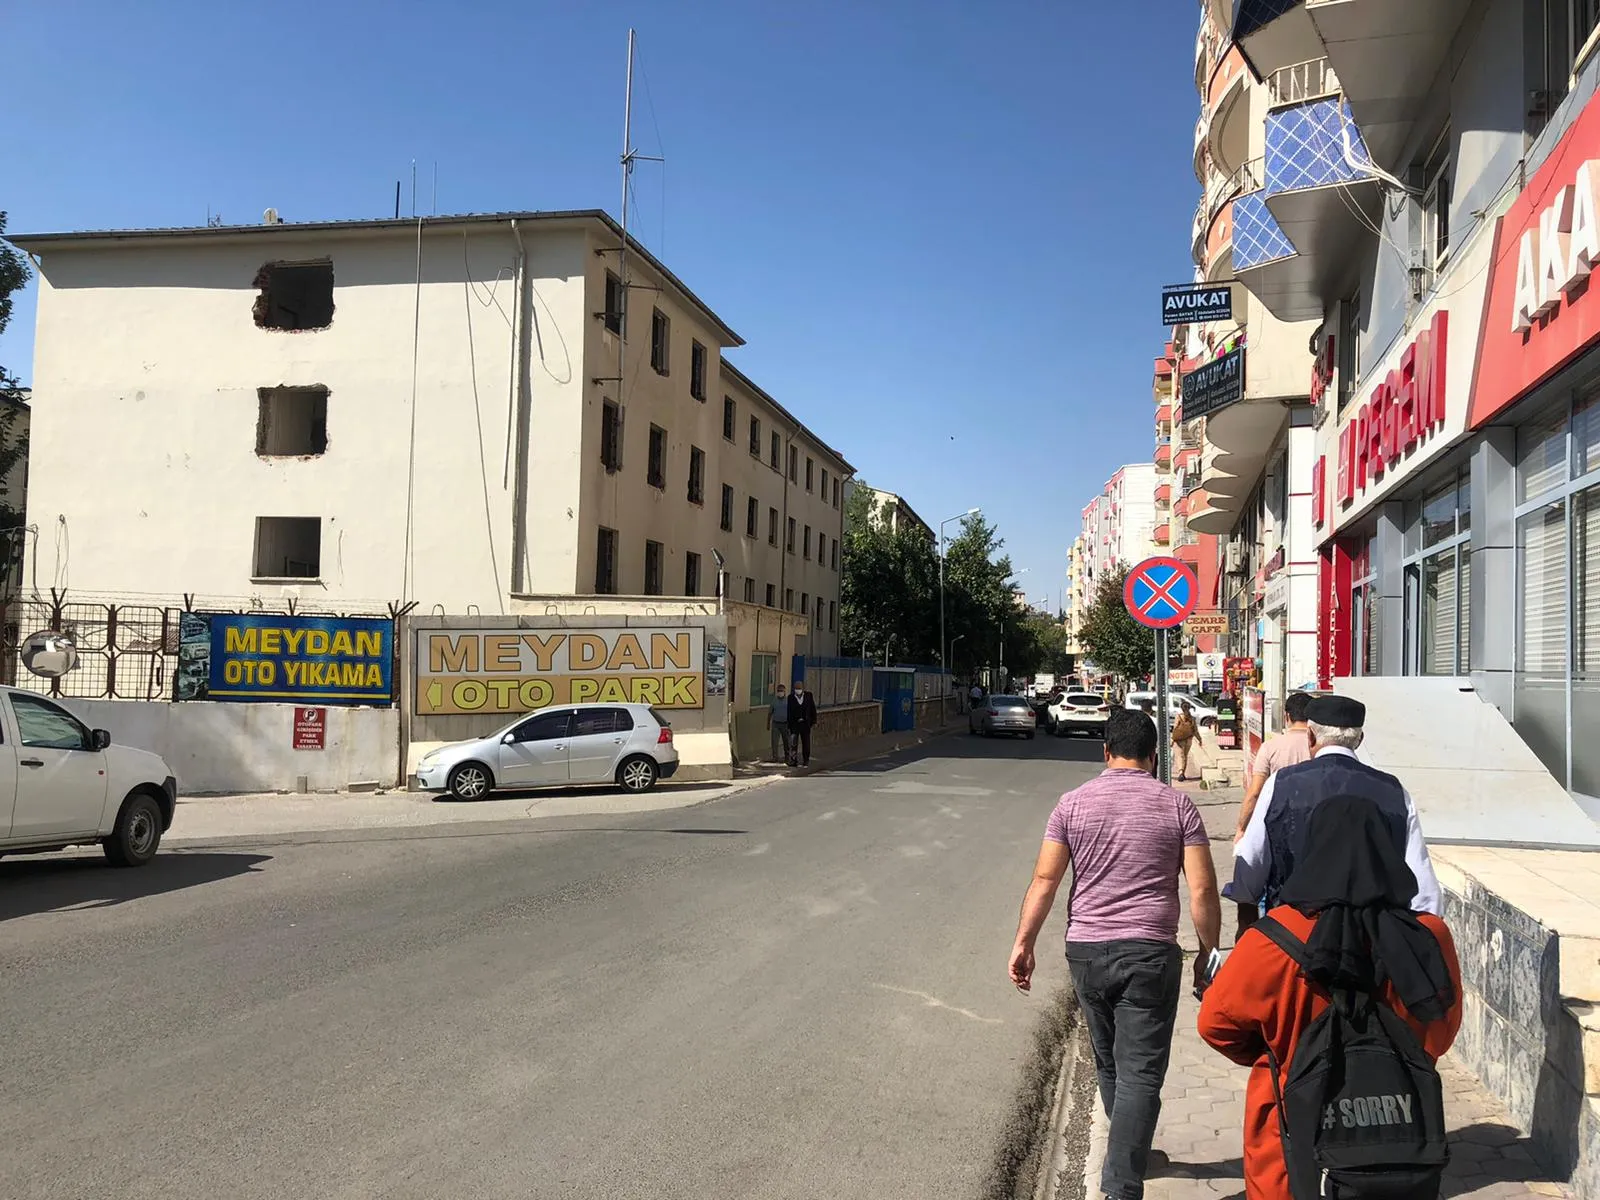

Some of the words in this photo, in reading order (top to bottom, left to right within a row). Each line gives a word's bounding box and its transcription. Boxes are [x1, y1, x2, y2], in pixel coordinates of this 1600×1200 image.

[1165, 291, 1229, 310] AVUKAT
[1195, 355, 1239, 393] AVUKAT
[1356, 311, 1449, 490] PEGEM
[1185, 616, 1226, 625] CEMRE
[1191, 625, 1222, 633] CAFE
[225, 626, 384, 657] MEYDAN
[429, 633, 691, 673] MEYDAN
[224, 659, 277, 685] OTO
[282, 661, 385, 688] YIKAMA
[1169, 672, 1195, 680] NOTER
[451, 678, 554, 710] OTO
[569, 676, 697, 705] PARK
